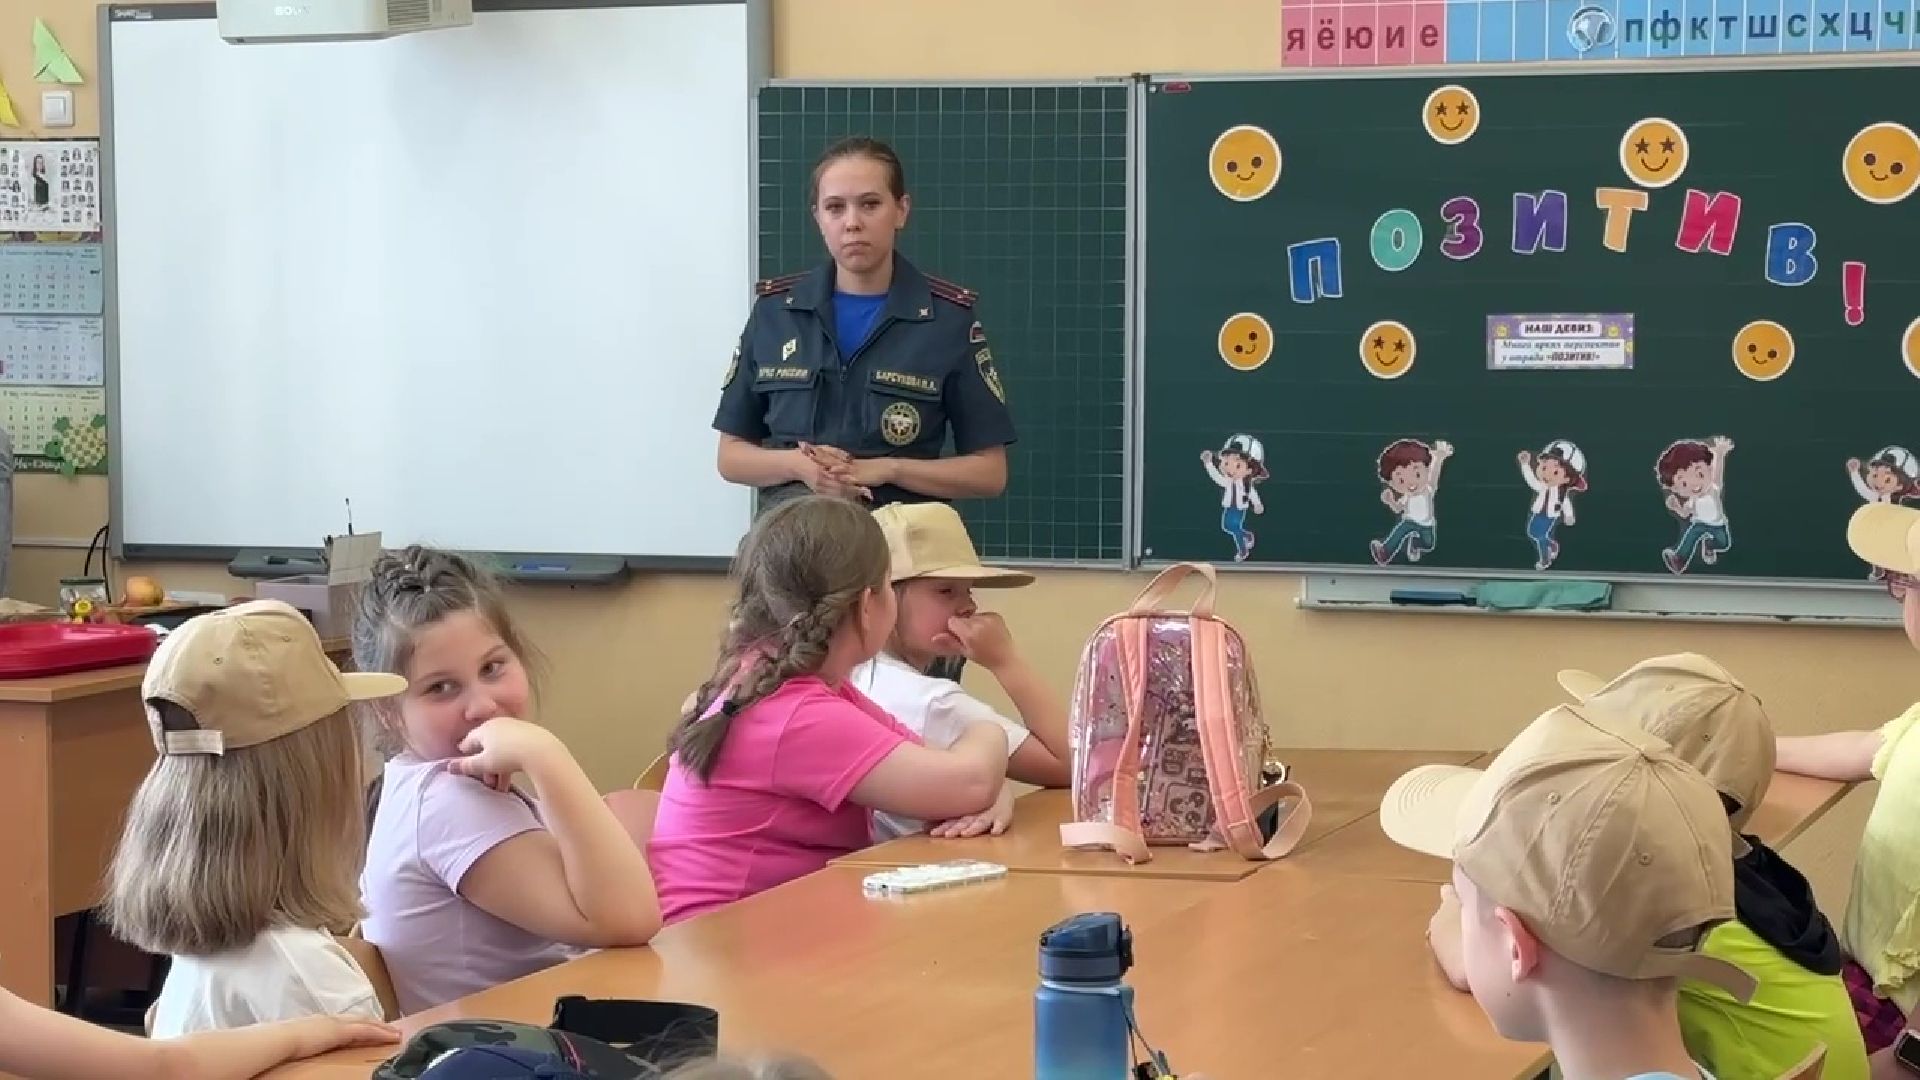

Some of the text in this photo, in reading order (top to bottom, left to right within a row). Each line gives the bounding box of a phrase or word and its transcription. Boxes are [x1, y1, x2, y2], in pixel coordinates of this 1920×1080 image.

[1287, 18, 1439, 51] я ё ю и е
[1626, 9, 1904, 49] п ф к т ш с х ц ч
[1287, 189, 1866, 326] ПОЗИТИВ!
[1524, 324, 1553, 334] НАШ
